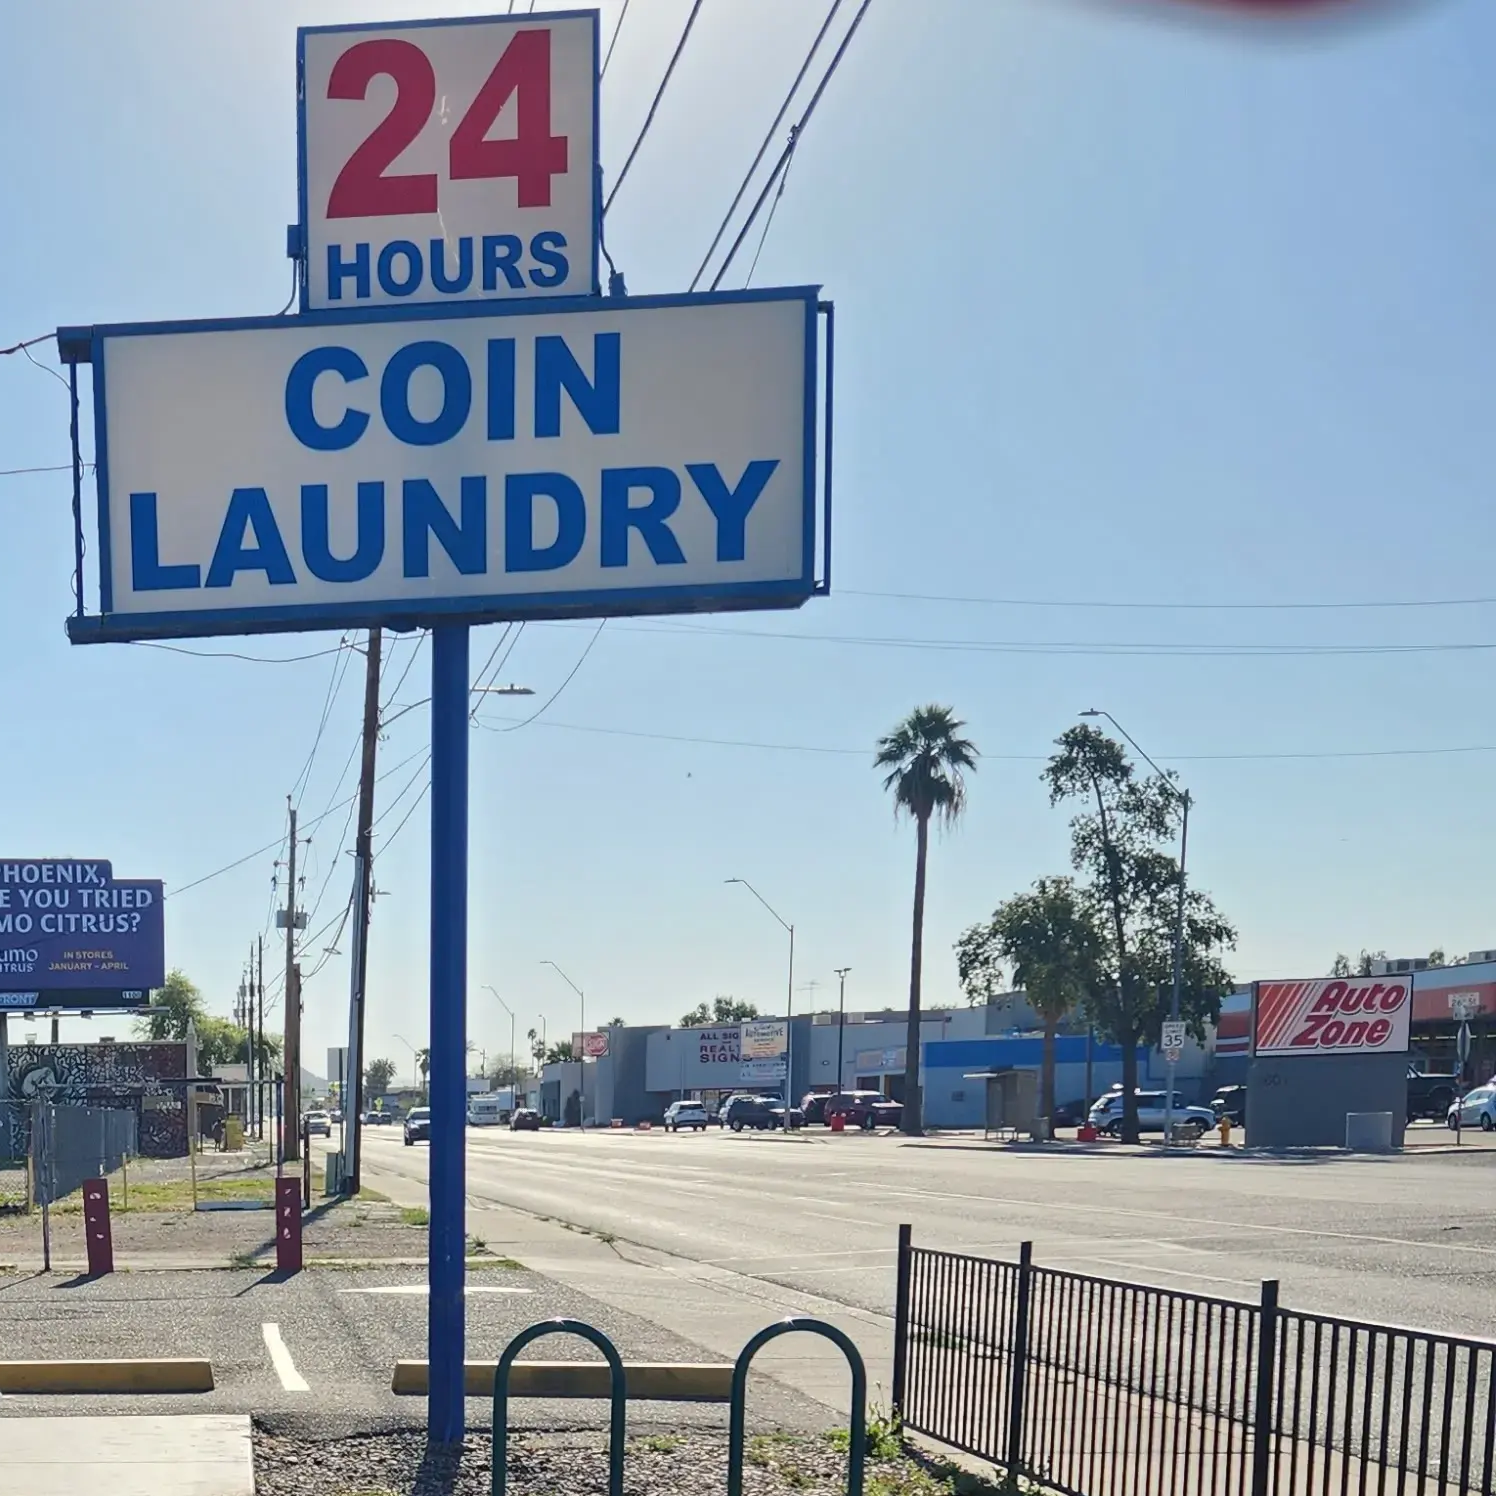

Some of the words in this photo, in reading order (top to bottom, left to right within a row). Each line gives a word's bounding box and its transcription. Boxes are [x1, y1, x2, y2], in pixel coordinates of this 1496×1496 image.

[326, 28, 568, 219] 24
[326, 230, 570, 301] HOURS
[285, 332, 621, 452] COIN
[129, 459, 780, 593] LAUNDRY
[18, 889, 70, 909] YOU
[78, 889, 153, 909] TRIED
[40, 912, 141, 933] CITRUS?
[48, 962, 93, 971] JANUARY
[100, 962, 129, 970] APRIL
[63, 951, 74, 959] IN
[75, 951, 114, 960] STORES
[1311, 981, 1406, 1014] Auto
[700, 1032, 719, 1040] ALL
[1164, 1034, 1183, 1047] 35
[1289, 1014, 1391, 1047] Zone
